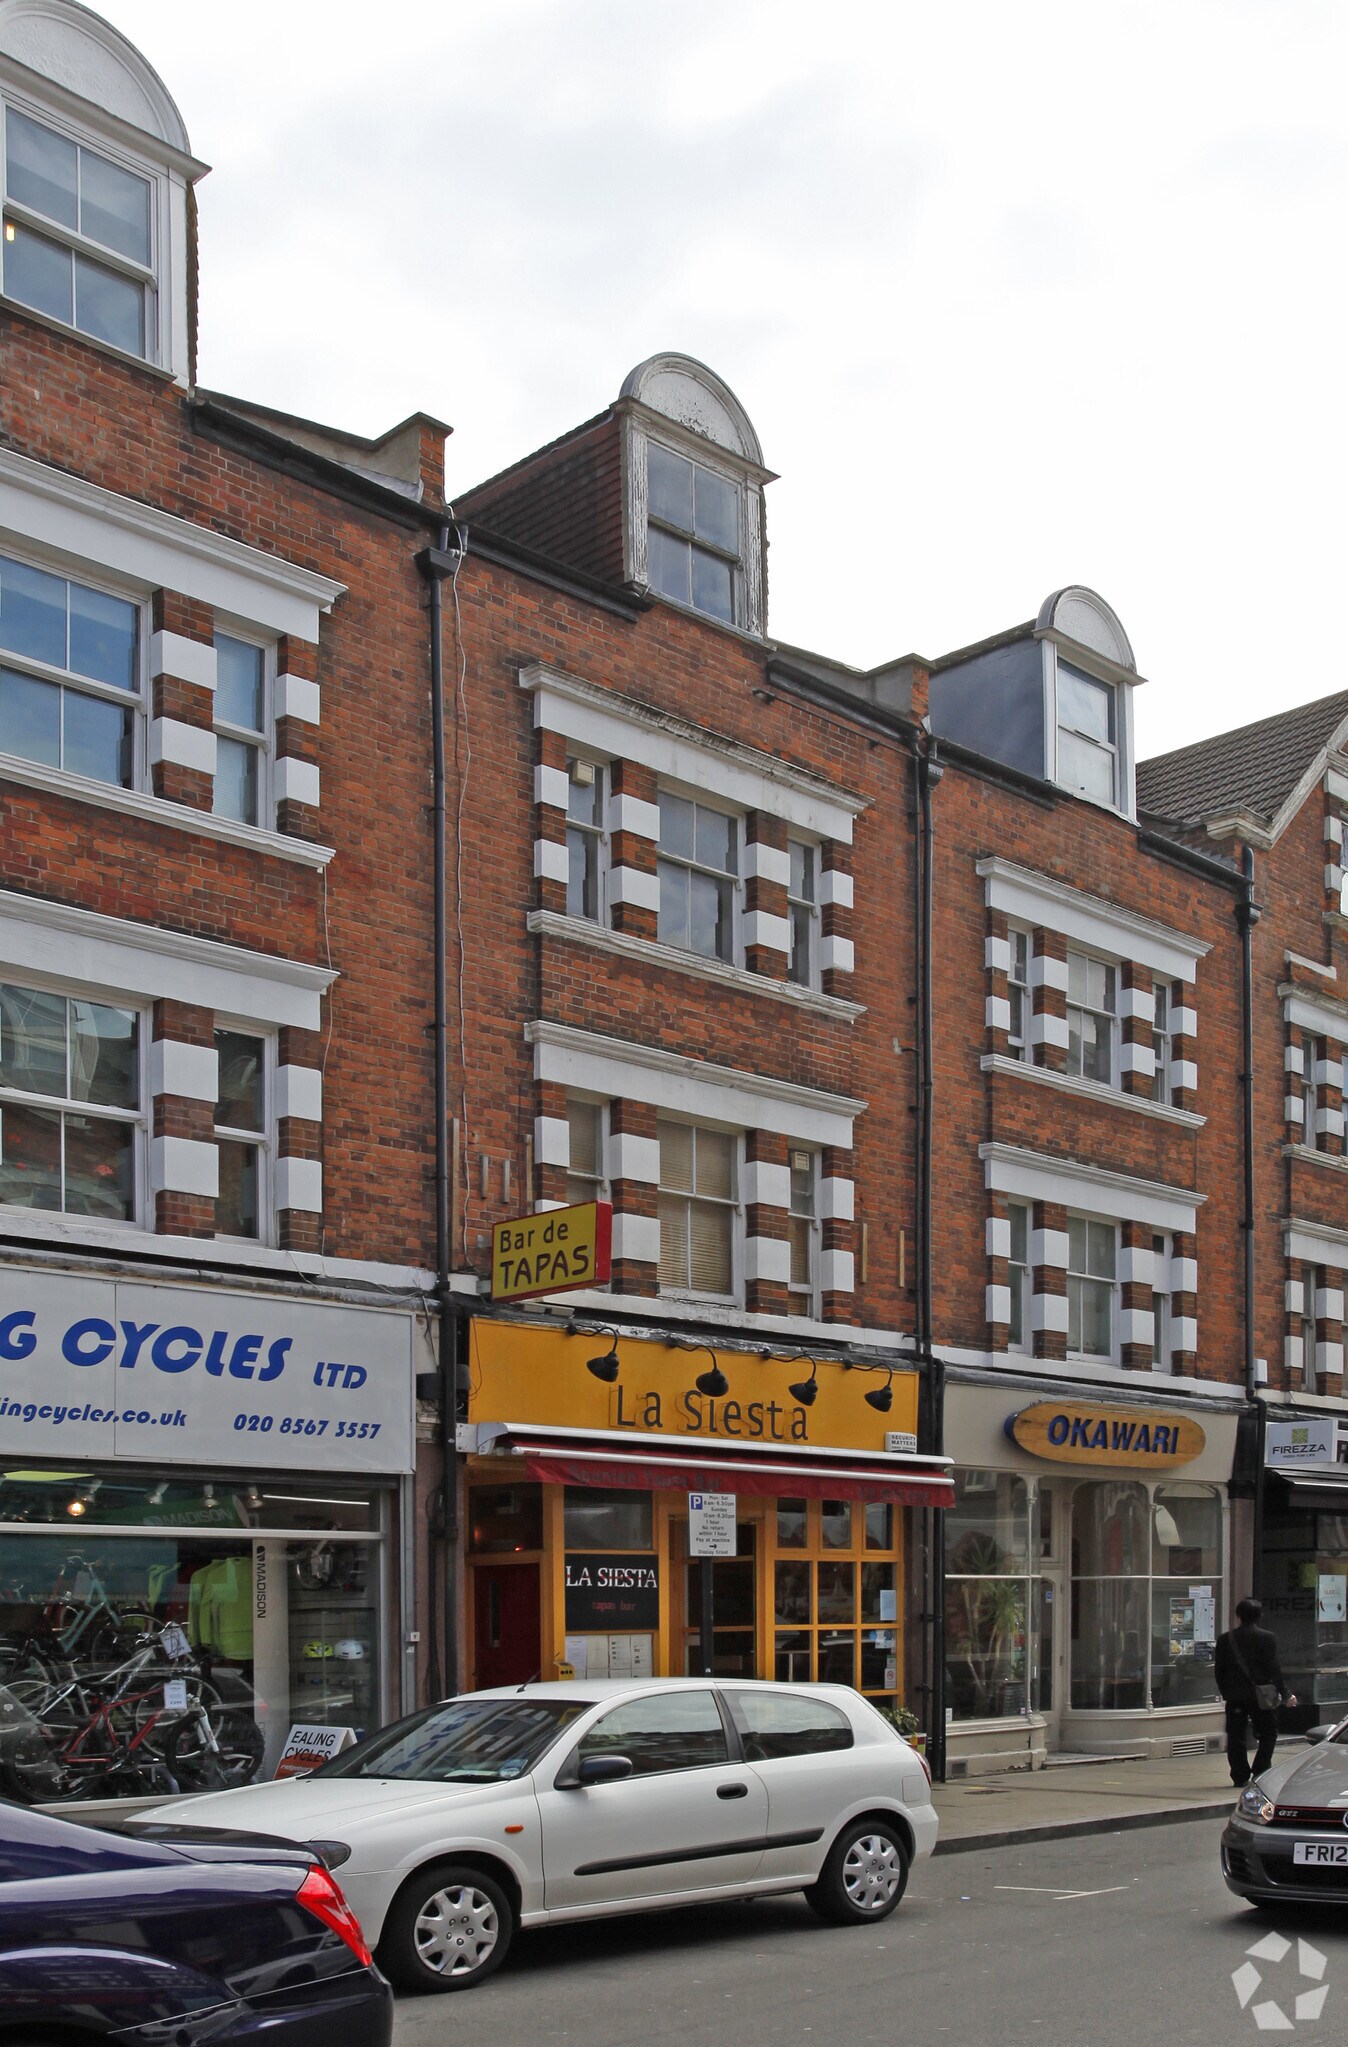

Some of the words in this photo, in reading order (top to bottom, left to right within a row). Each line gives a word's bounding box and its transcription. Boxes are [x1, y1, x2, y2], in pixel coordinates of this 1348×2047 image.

[500, 1229, 535, 1253] Bar
[543, 1219, 569, 1244] de
[500, 1244, 589, 1290] TAPAS
[61, 1317, 293, 1382] CYCLES
[313, 1361, 368, 1390] LTD
[233, 1413, 274, 1432] 020
[279, 1417, 330, 1436] 8567
[334, 1421, 382, 1440] 3557
[617, 1385, 663, 1428] La
[684, 1389, 808, 1441] Siesta
[1047, 1414, 1180, 1455] OKAWARI
[1272, 1443, 1327, 1455] FIREZZA
[162, 1507, 234, 1525] MADISON
[693, 1496, 701, 1509] P
[565, 1565, 593, 1587] LA
[597, 1567, 658, 1588] SIESTA
[256, 1562, 267, 1619] MADISON
[291, 1731, 336, 1747] EALING
[284, 1747, 332, 1763] CYCLES
